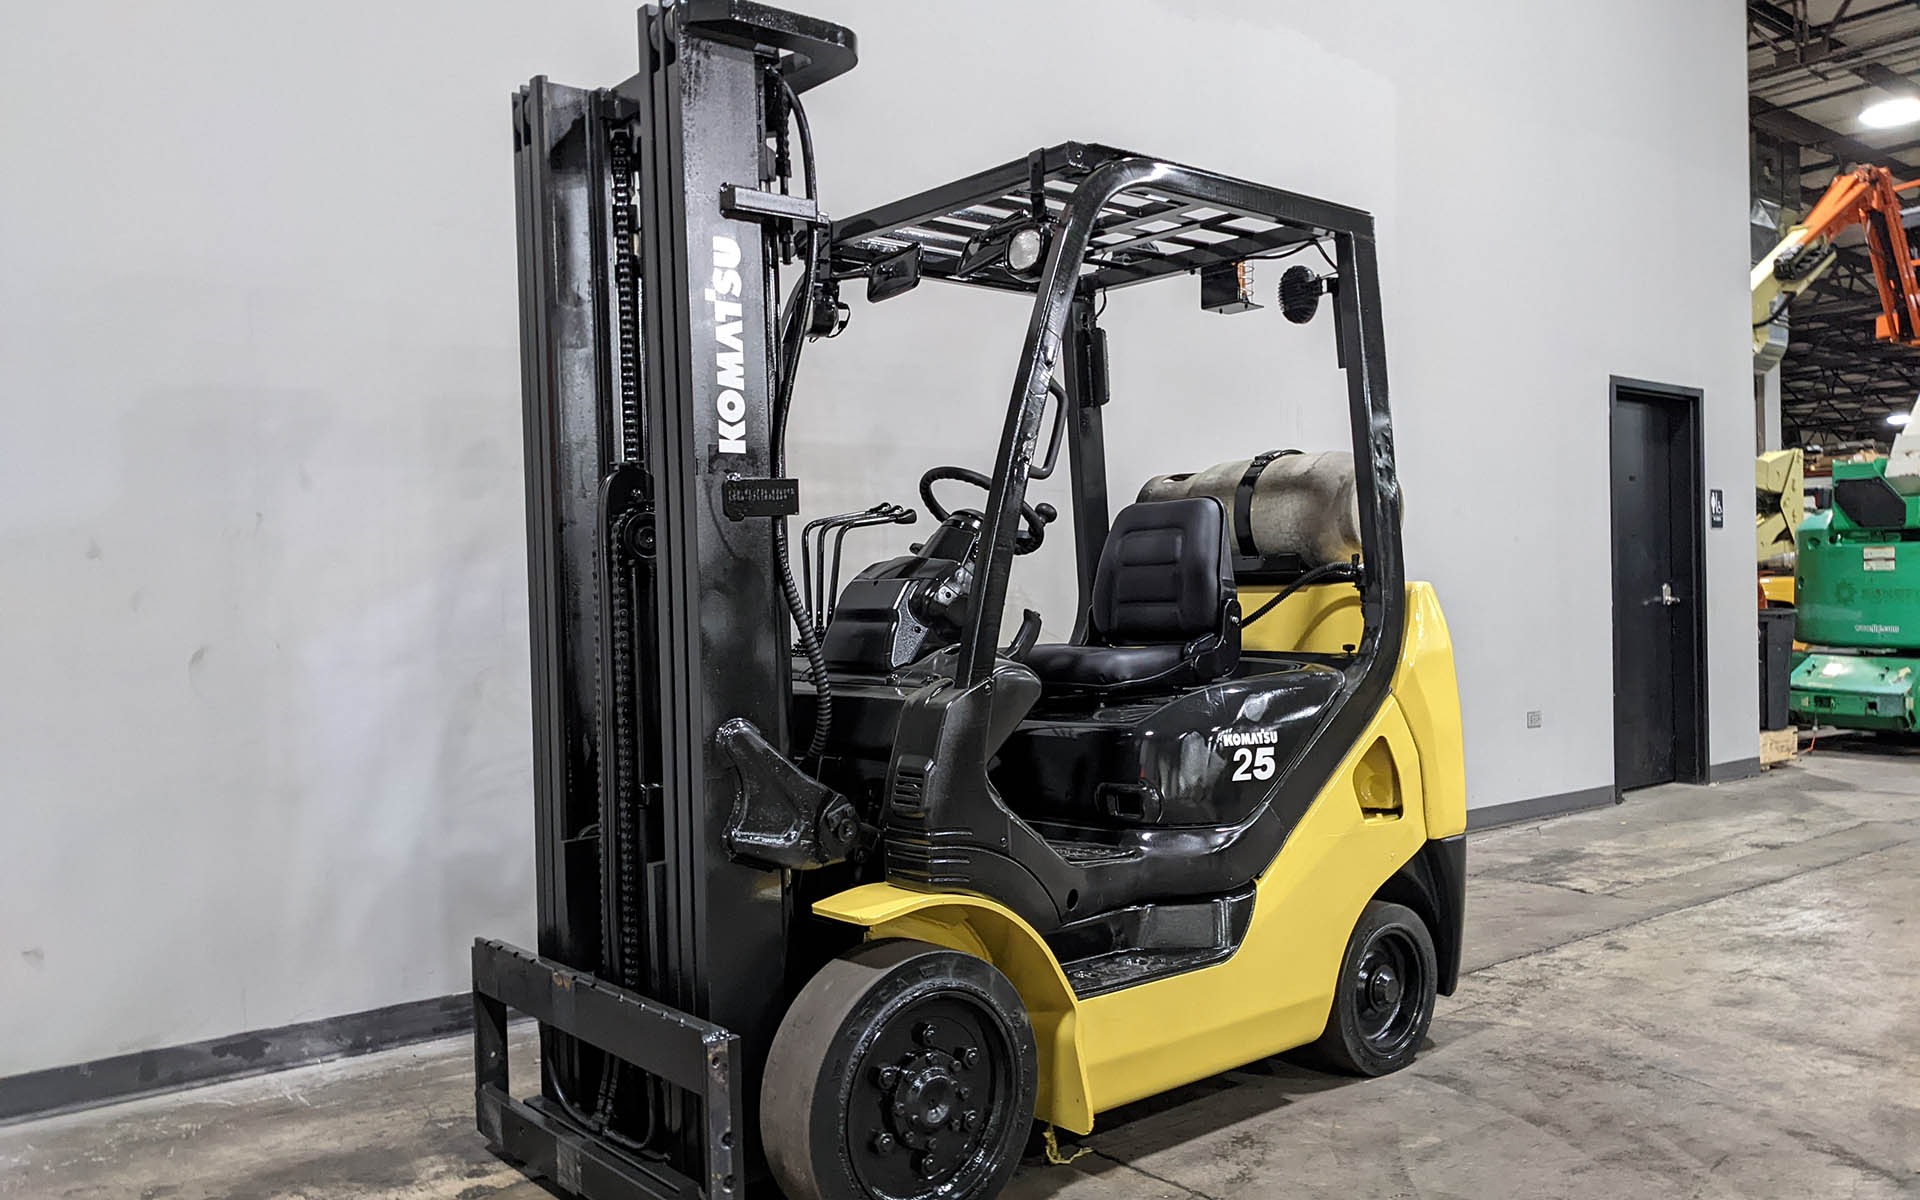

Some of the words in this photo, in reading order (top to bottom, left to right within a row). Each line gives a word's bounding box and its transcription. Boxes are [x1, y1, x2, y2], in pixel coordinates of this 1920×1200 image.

[705, 236, 746, 454] KOMATSU
[1223, 728, 1278, 747] KOMATSU
[1231, 746, 1276, 782] 25
